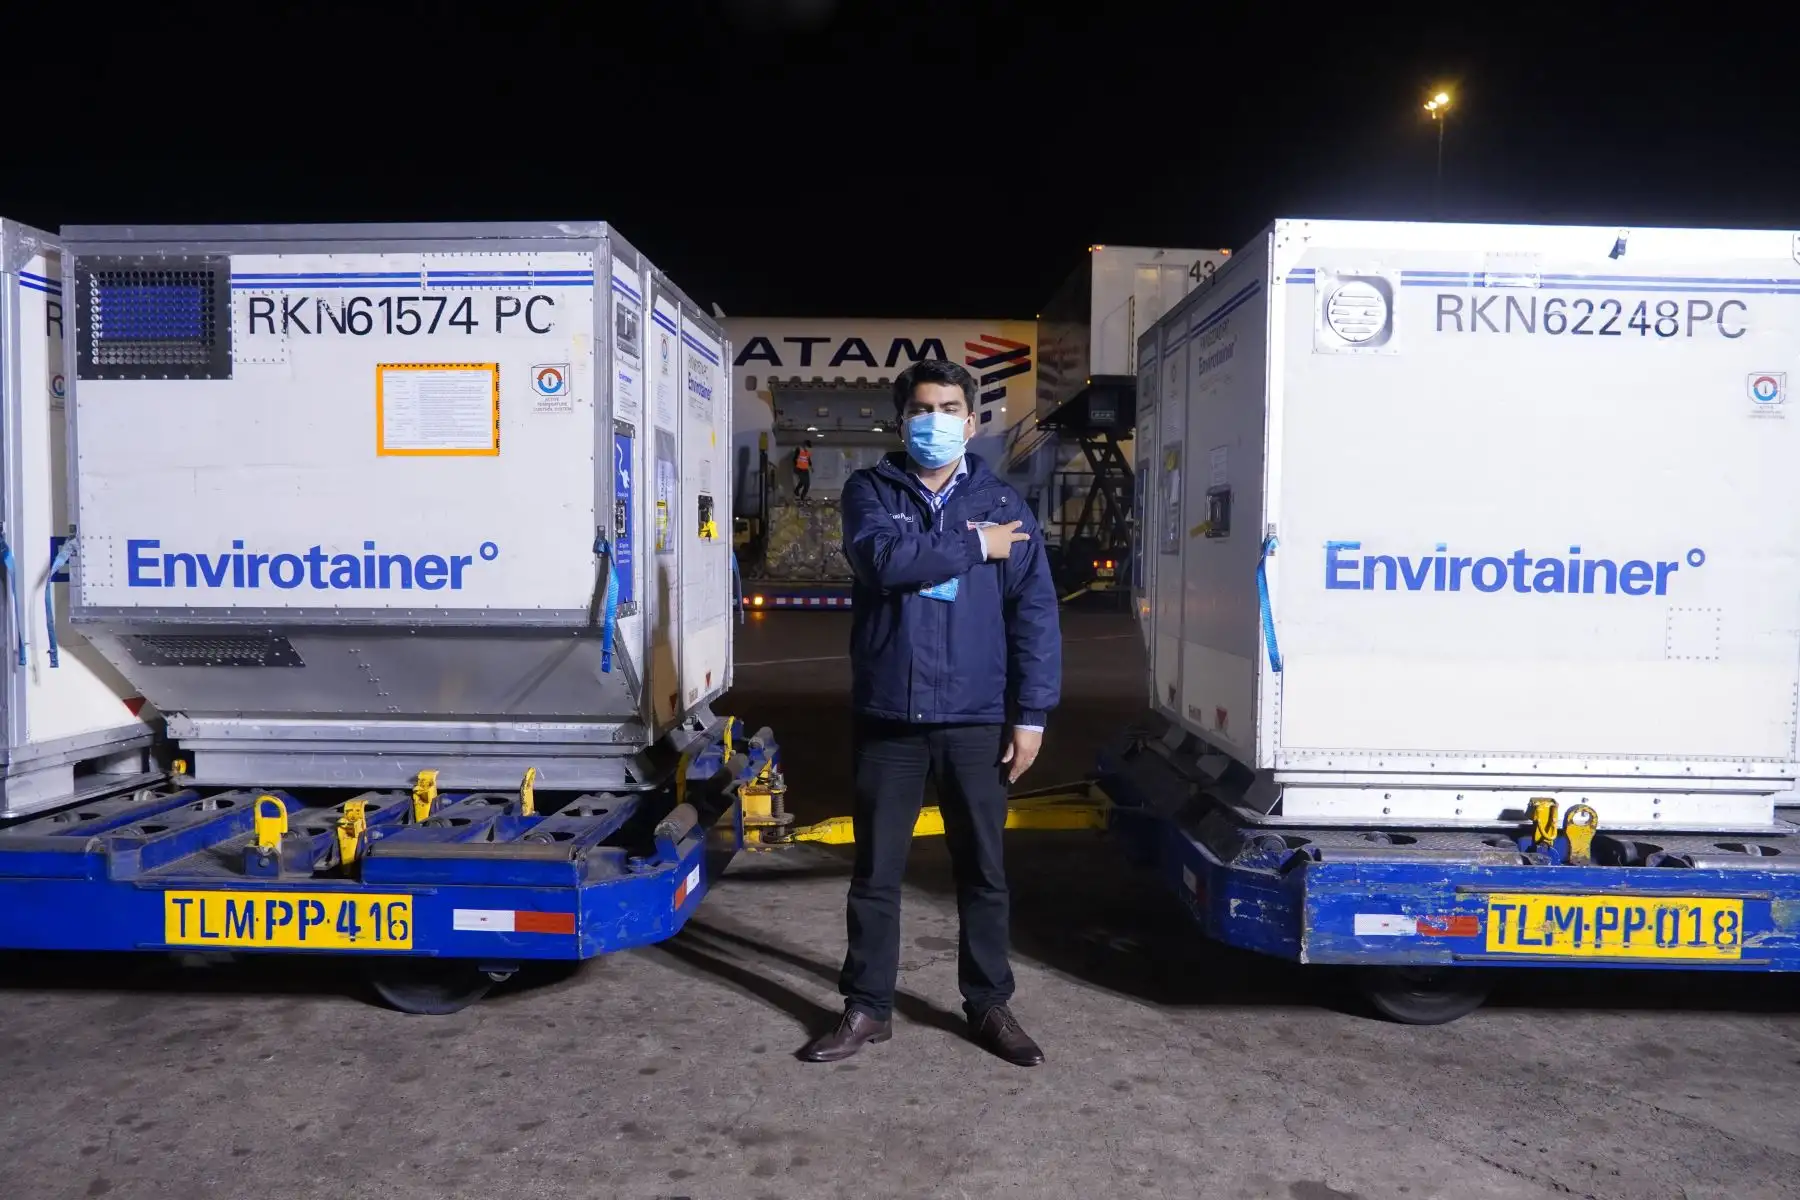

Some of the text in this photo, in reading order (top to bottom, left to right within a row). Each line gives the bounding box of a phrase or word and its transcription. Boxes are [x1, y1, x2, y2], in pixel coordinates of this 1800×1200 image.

[249, 294, 556, 335] RKN61574 PC
[1436, 293, 1748, 339] RKN62248PC
